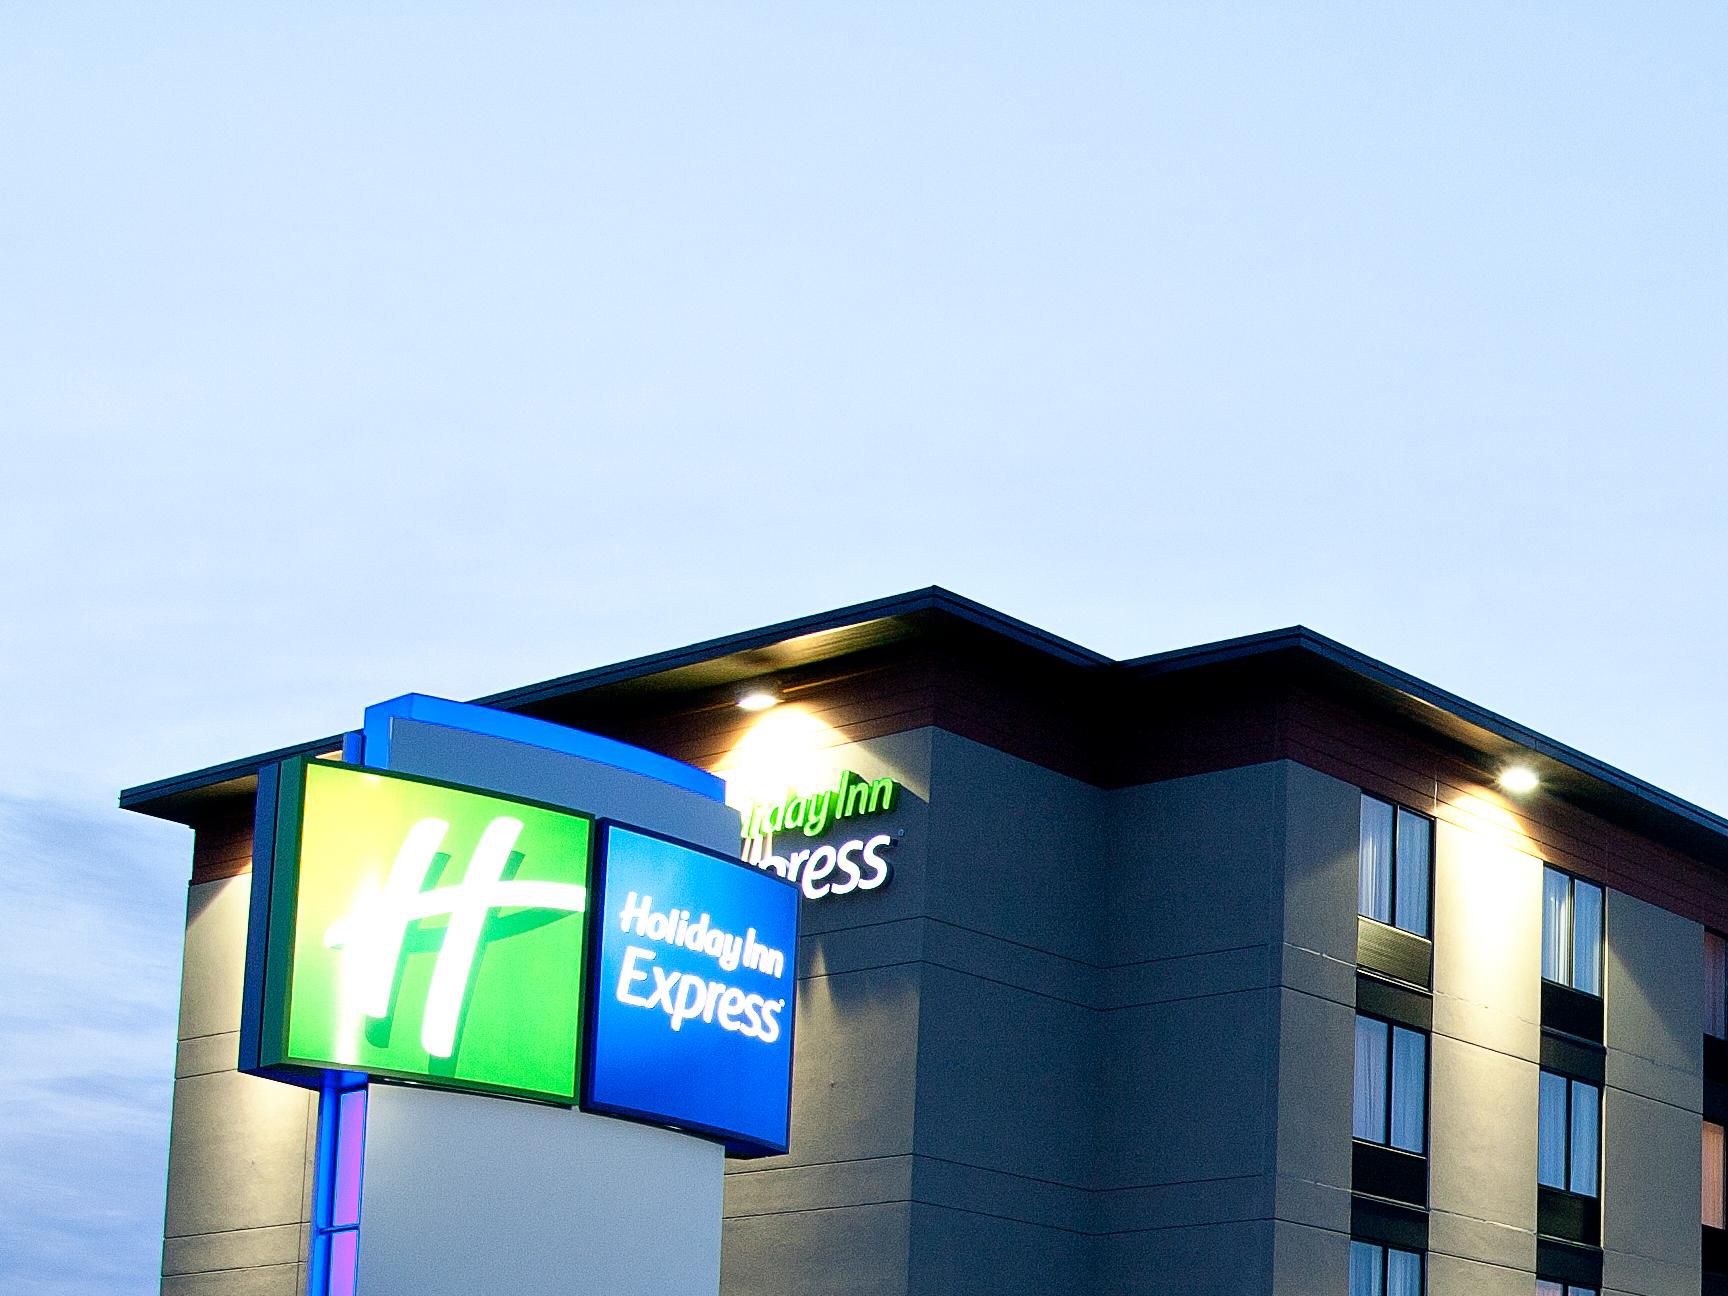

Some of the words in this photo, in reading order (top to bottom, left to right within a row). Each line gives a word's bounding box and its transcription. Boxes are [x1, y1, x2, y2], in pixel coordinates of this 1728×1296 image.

[835, 769, 894, 820] Inn
[619, 891, 744, 972] Holiday
[742, 927, 785, 979] Inn
[616, 945, 782, 1043] Express
